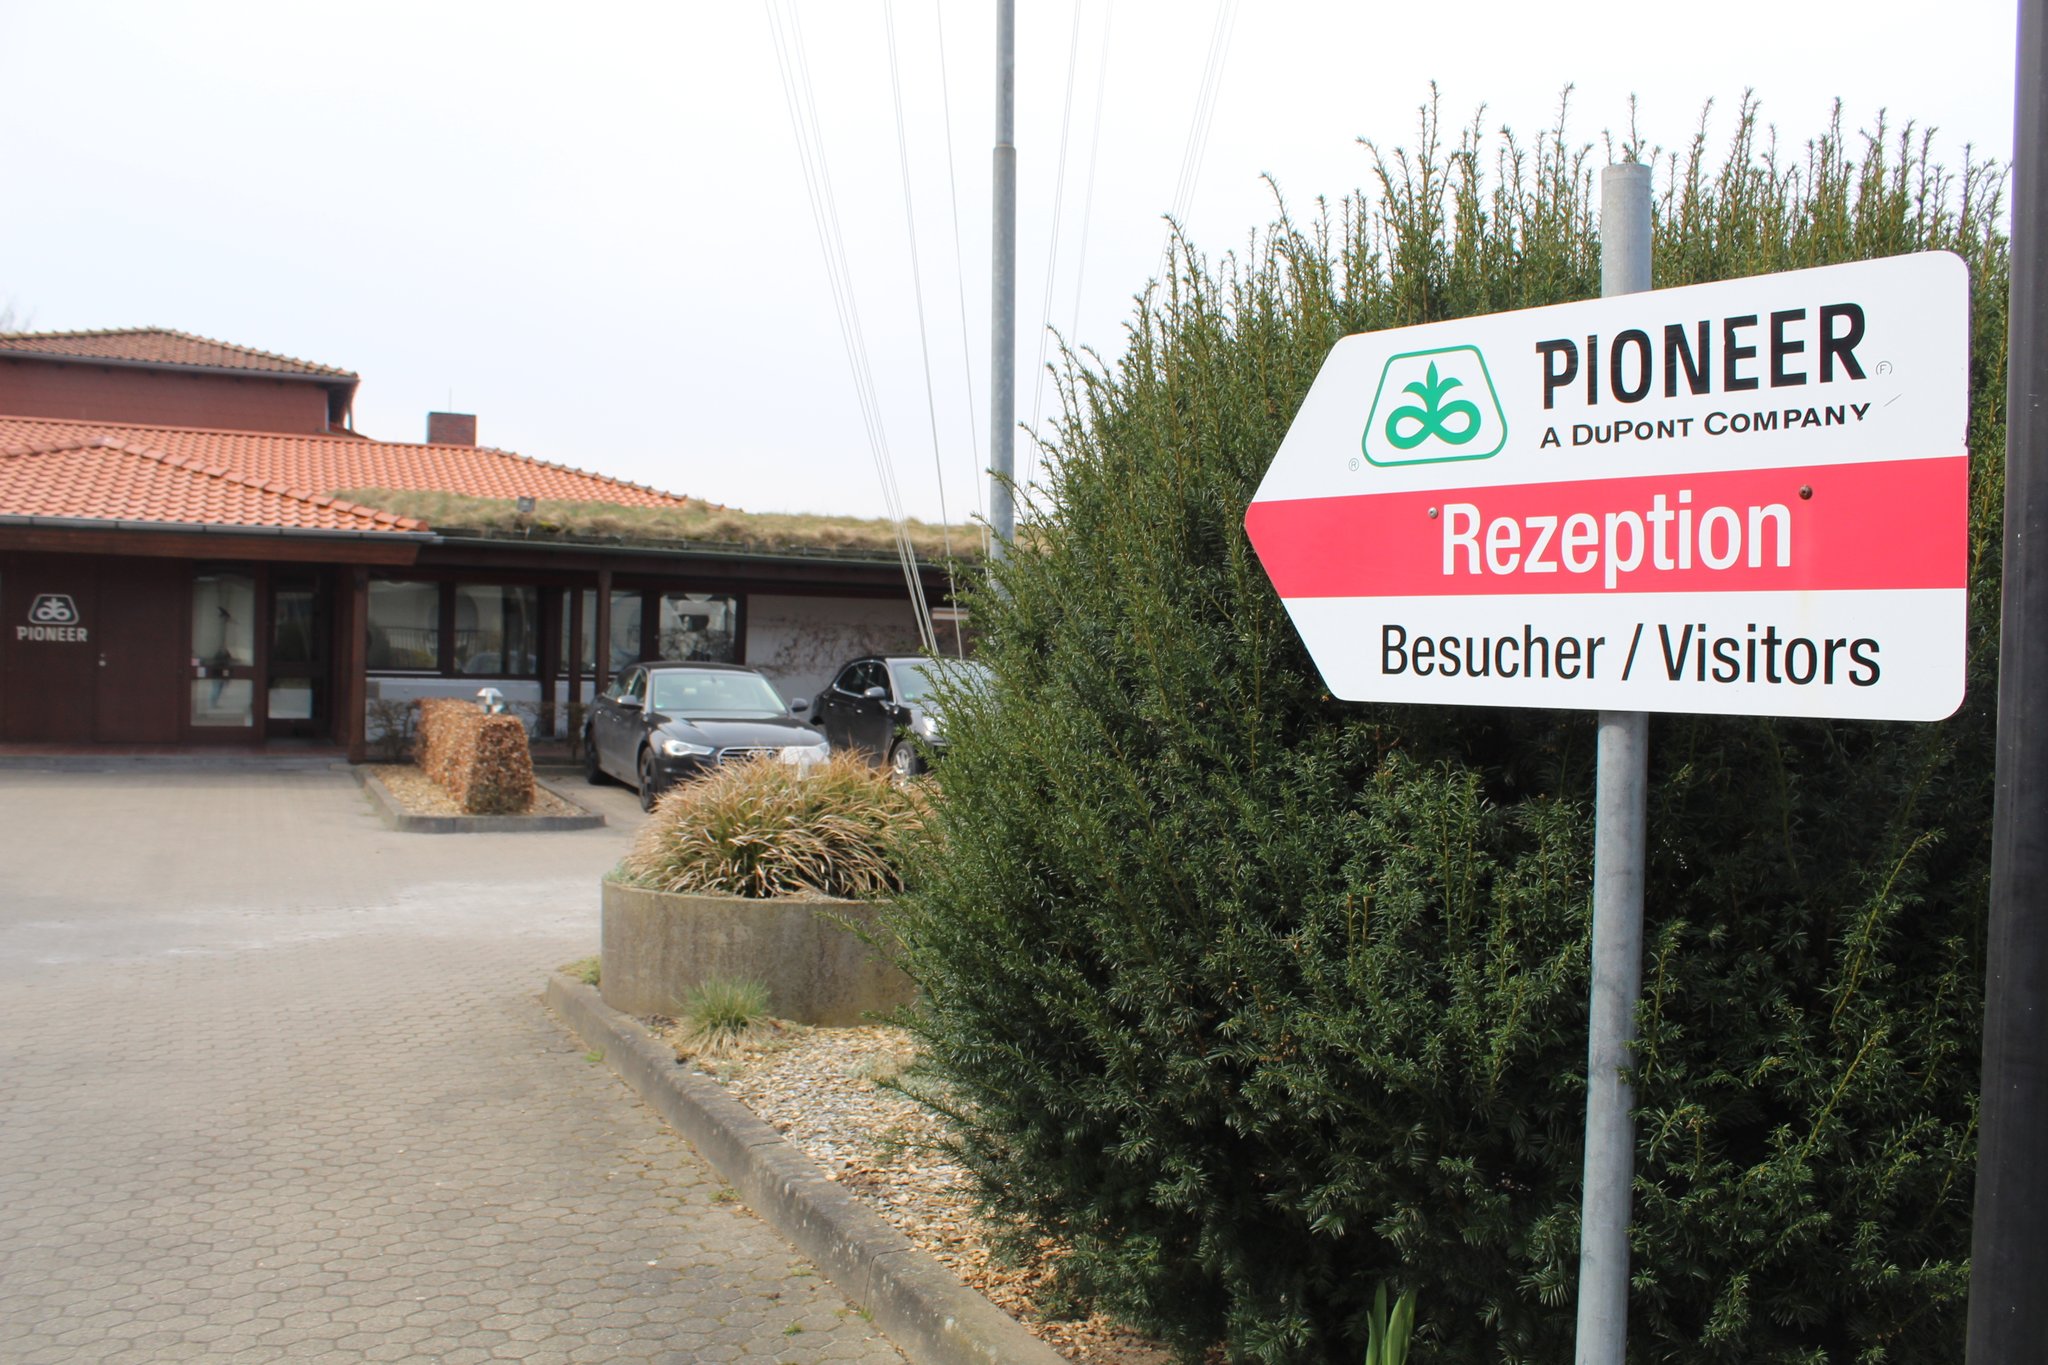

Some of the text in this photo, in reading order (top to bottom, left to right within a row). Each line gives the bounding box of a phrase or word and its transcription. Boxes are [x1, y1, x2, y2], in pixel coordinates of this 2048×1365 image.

[1535, 302, 1867, 410] PIONEER
[1540, 426, 1561, 449] A
[1704, 402, 1871, 436] COMPANY
[1443, 489, 1792, 590] Rezeption
[16, 625, 88, 642] PIONEER
[1382, 624, 1606, 680] Besucher
[1657, 623, 1881, 688] Visitors
